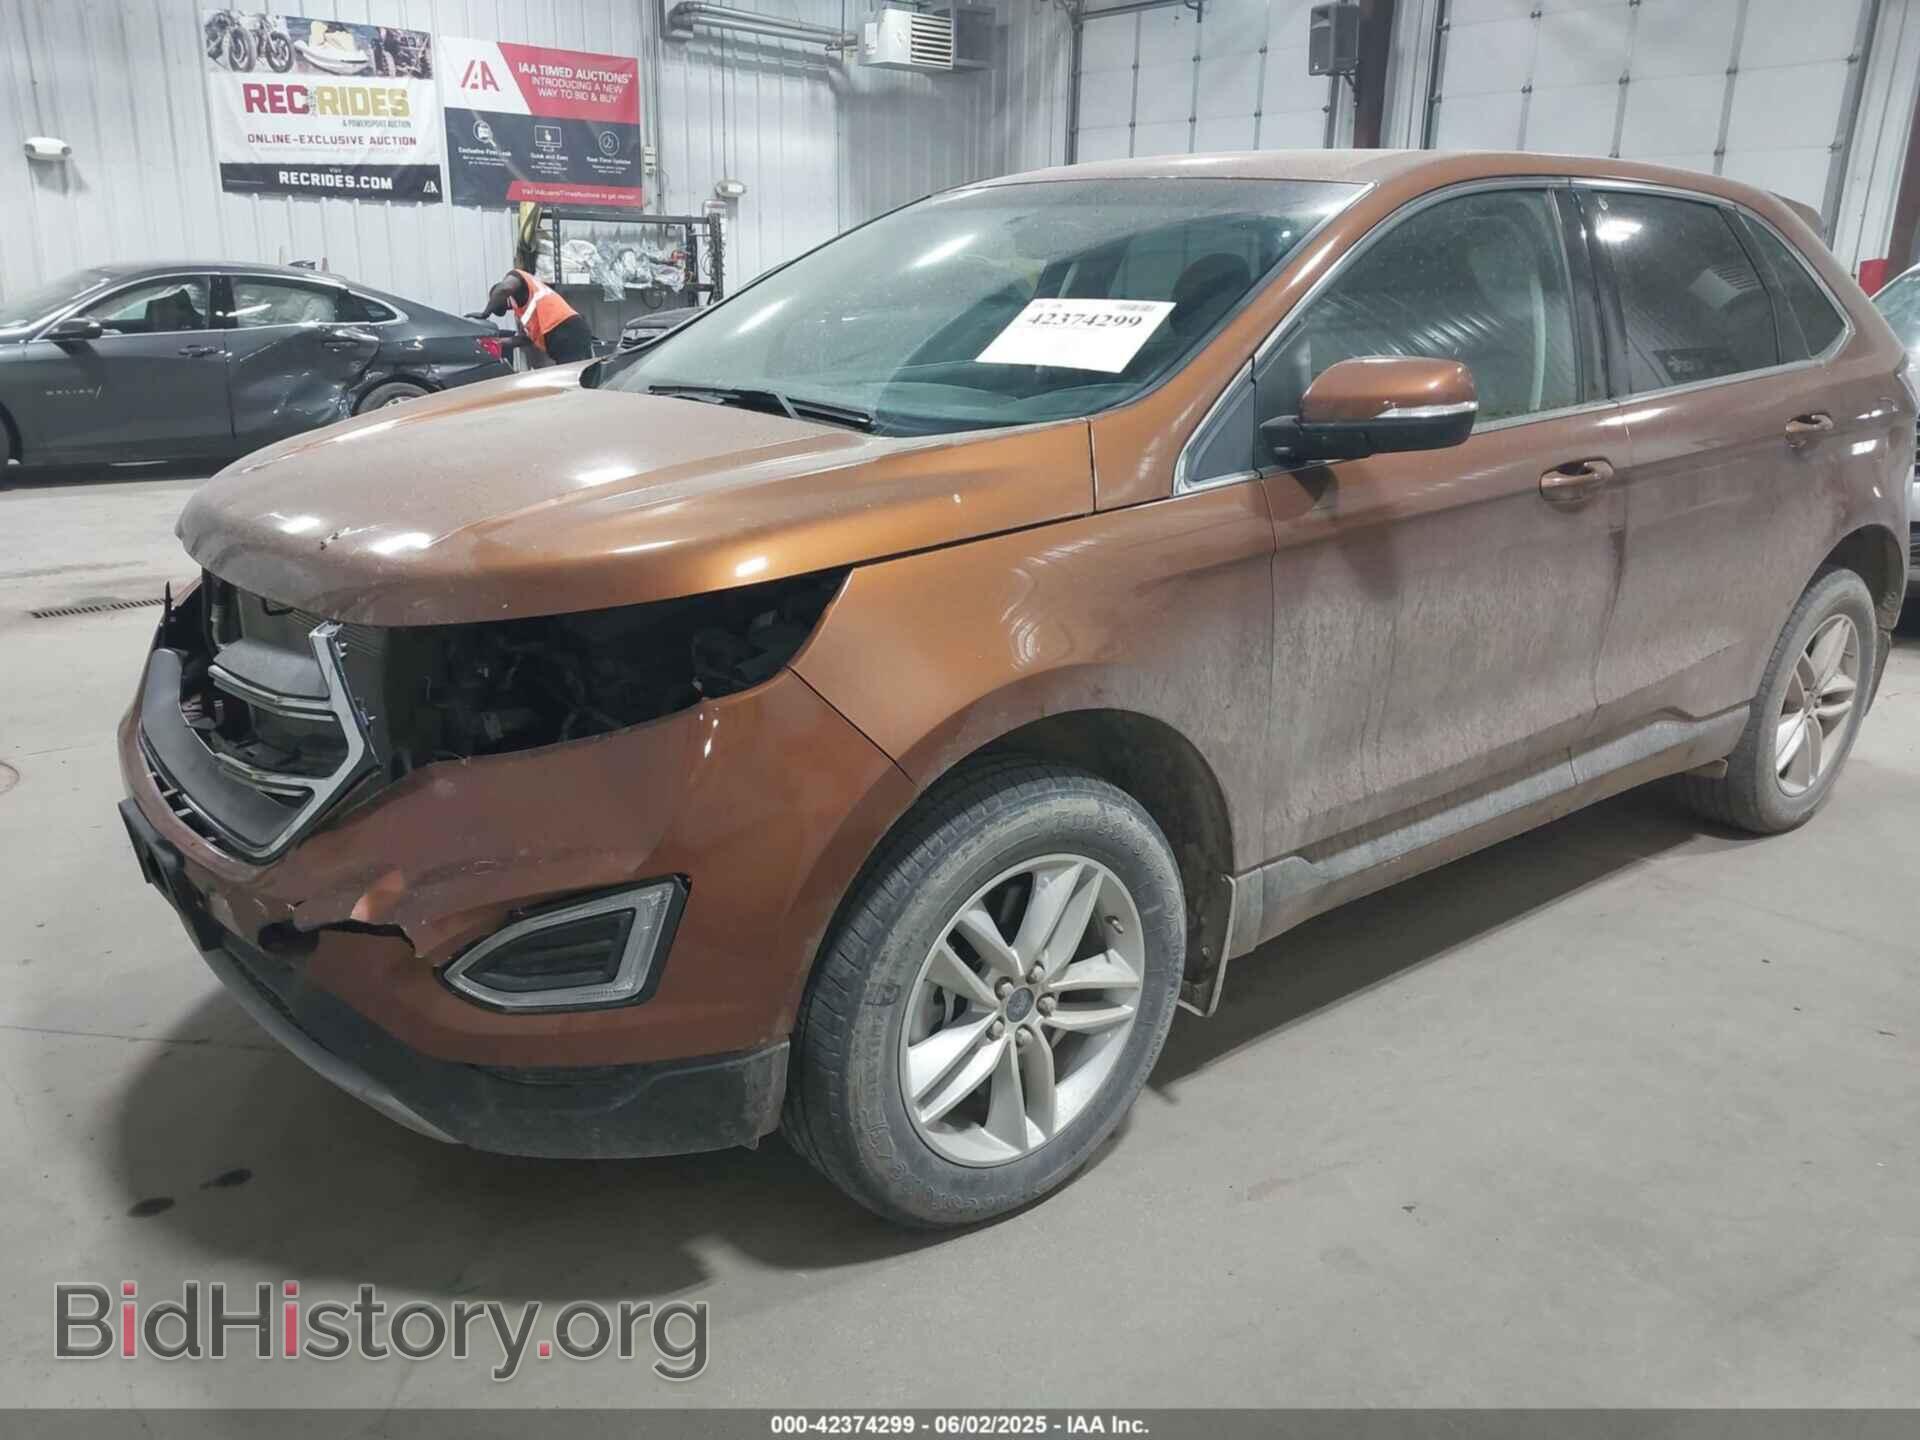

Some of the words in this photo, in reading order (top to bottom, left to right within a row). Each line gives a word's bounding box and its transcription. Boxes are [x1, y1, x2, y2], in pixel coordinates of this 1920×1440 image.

[518, 62, 537, 74] IAA
[538, 64, 573, 78] TIMED
[532, 77, 592, 91] INTRODUCING
[594, 83, 601, 91] A
[603, 84, 623, 94] NEW
[242, 83, 310, 114] REC
[317, 86, 410, 117] RIDES
[538, 87, 558, 97] WAY
[560, 89, 572, 99] TO
[575, 91, 589, 100] BID
[600, 93, 618, 103] BUY
[247, 134, 364, 145] ONLINE-EXCLUSIVE
[369, 136, 417, 145] AUCTION
[278, 171, 393, 190] RECRIDES.COM
[1027, 312, 1143, 327] 42374299
